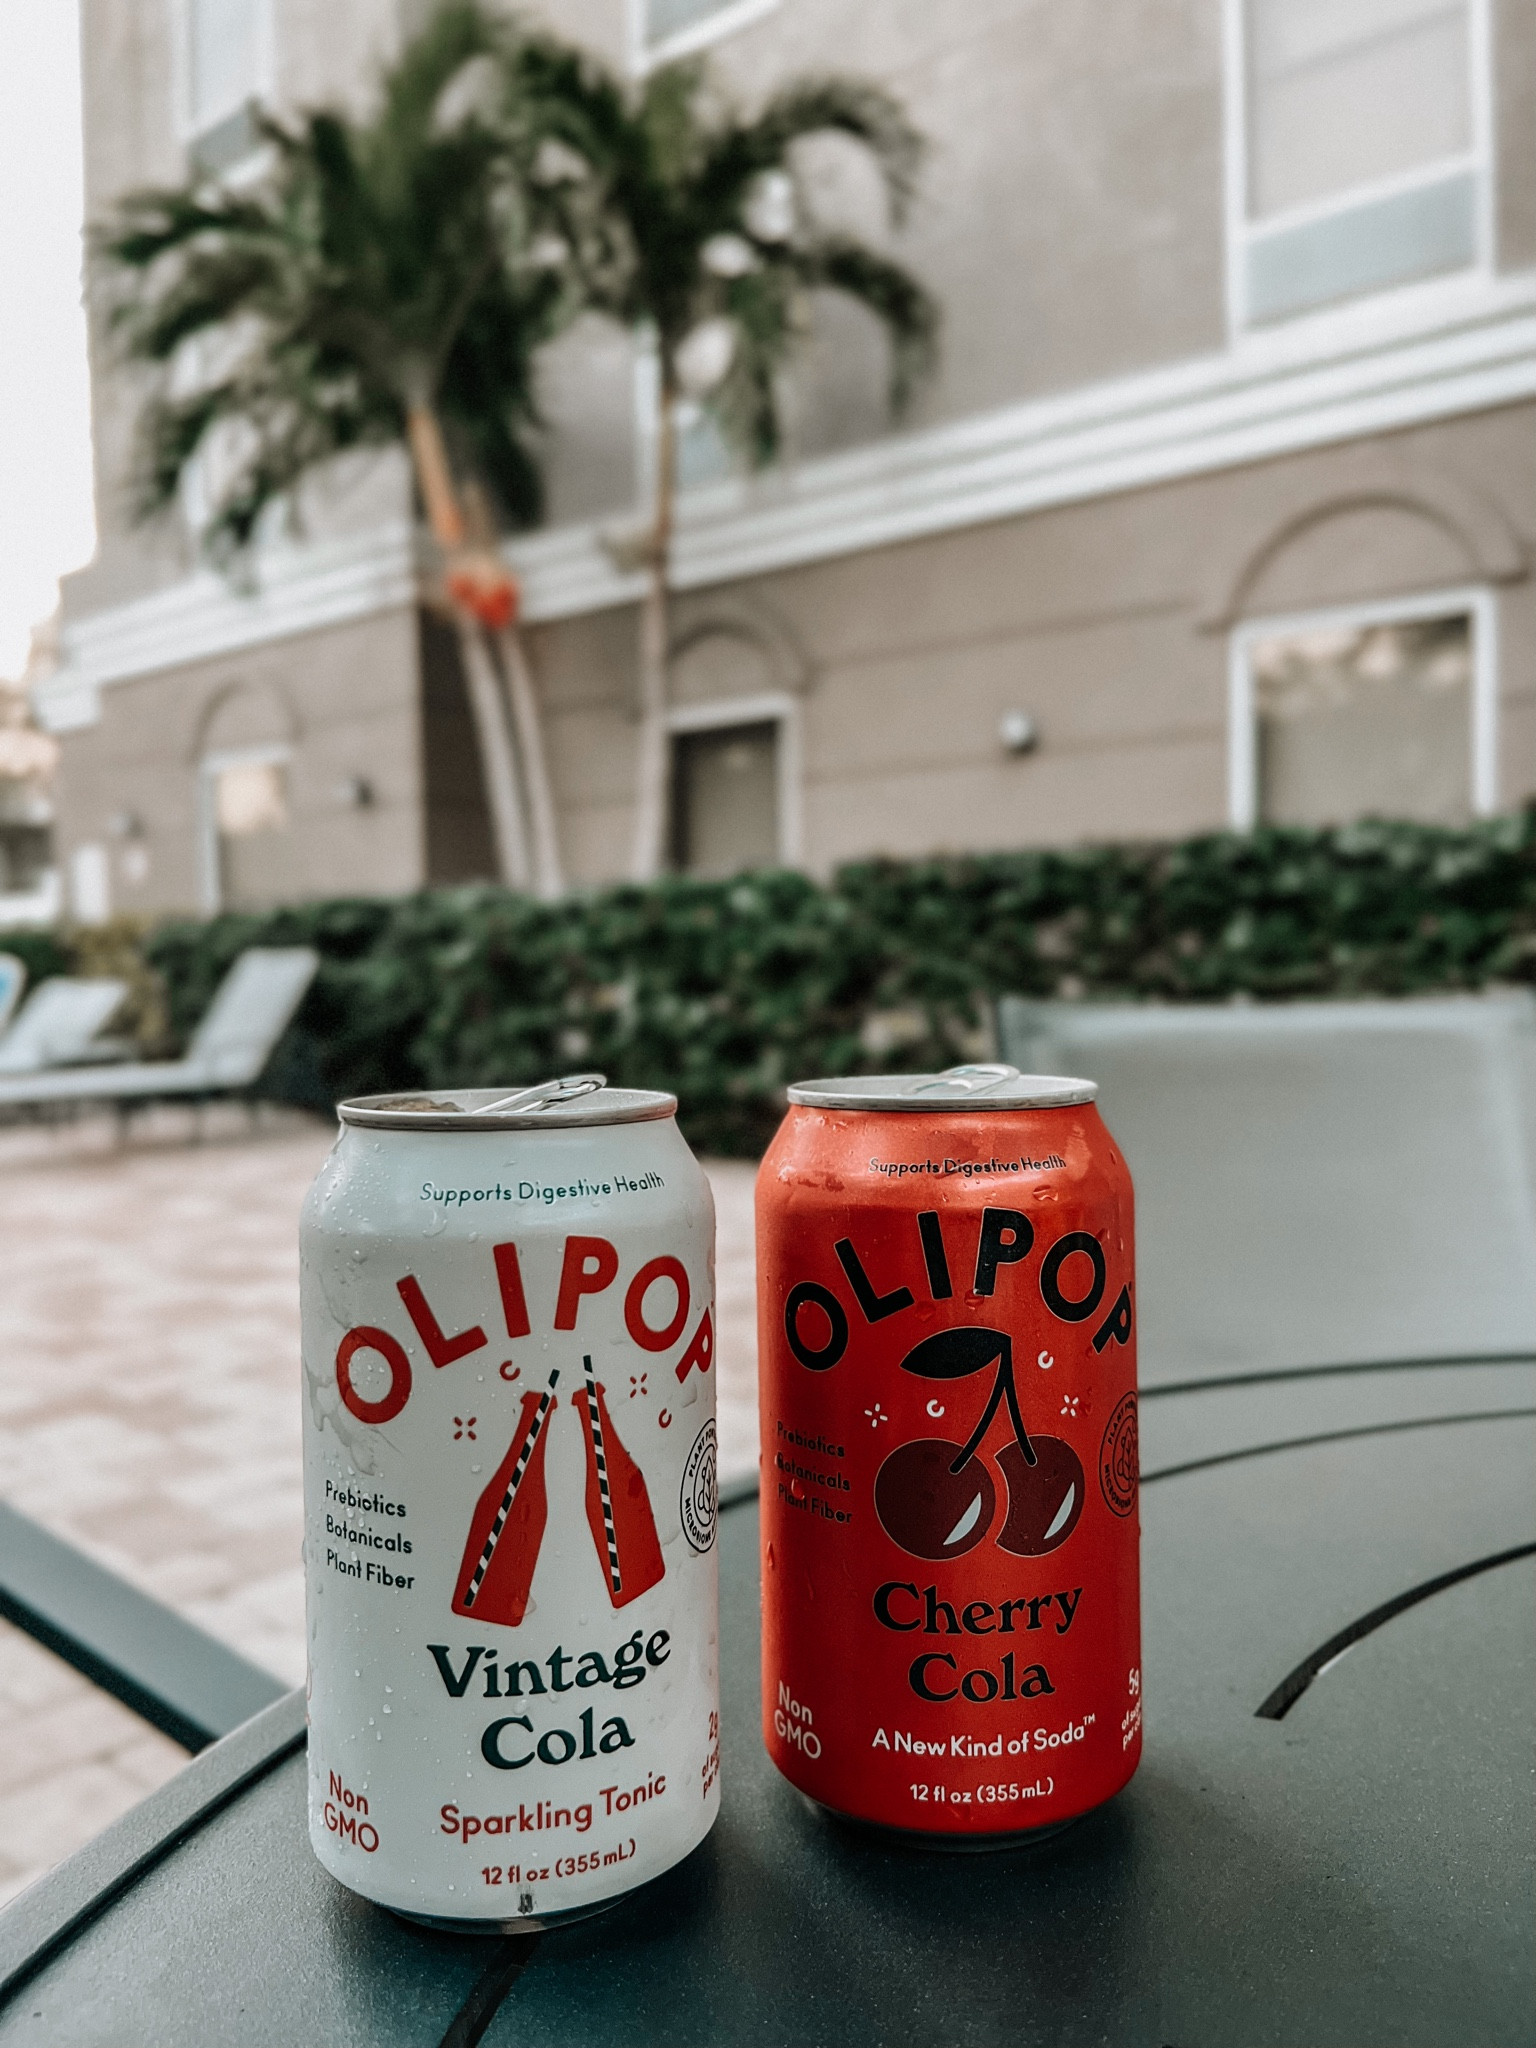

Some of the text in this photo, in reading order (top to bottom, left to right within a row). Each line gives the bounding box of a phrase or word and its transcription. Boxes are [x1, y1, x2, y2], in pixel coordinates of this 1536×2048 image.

[420, 1171, 665, 1206] Supports Digestive Health
[868, 1155, 1067, 1178] Supports Digestive Health
[784, 1206, 1132, 1373] OLIPOP
[336, 1235, 714, 1425] OLIPOP
[777, 1420, 845, 1457] Prebiotics
[776, 1451, 850, 1491] Botanicals
[326, 1480, 406, 1517] Prebiotics
[778, 1482, 852, 1523] Plant Fiber
[326, 1514, 412, 1554] Botanicals
[327, 1548, 415, 1589] Plant Fiber
[873, 1580, 1083, 1636] Cherry
[427, 1629, 671, 1698] Vintage
[908, 1652, 1056, 1703] Cola
[779, 1680, 812, 1725] Non
[481, 1707, 636, 1770] Cola
[774, 1709, 821, 1759] GMO
[872, 1728, 890, 1750] A
[895, 1730, 946, 1756] New
[951, 1734, 1002, 1757] Kind
[1007, 1731, 1029, 1754] of
[330, 1768, 368, 1815] Non
[440, 1771, 666, 1844] Sparkling Tonic
[910, 1776, 1054, 1804] 12 fl oz (355 mL)
[324, 1802, 379, 1852] GMO
[481, 1838, 636, 1885] 12 fl oz (355 mL)
